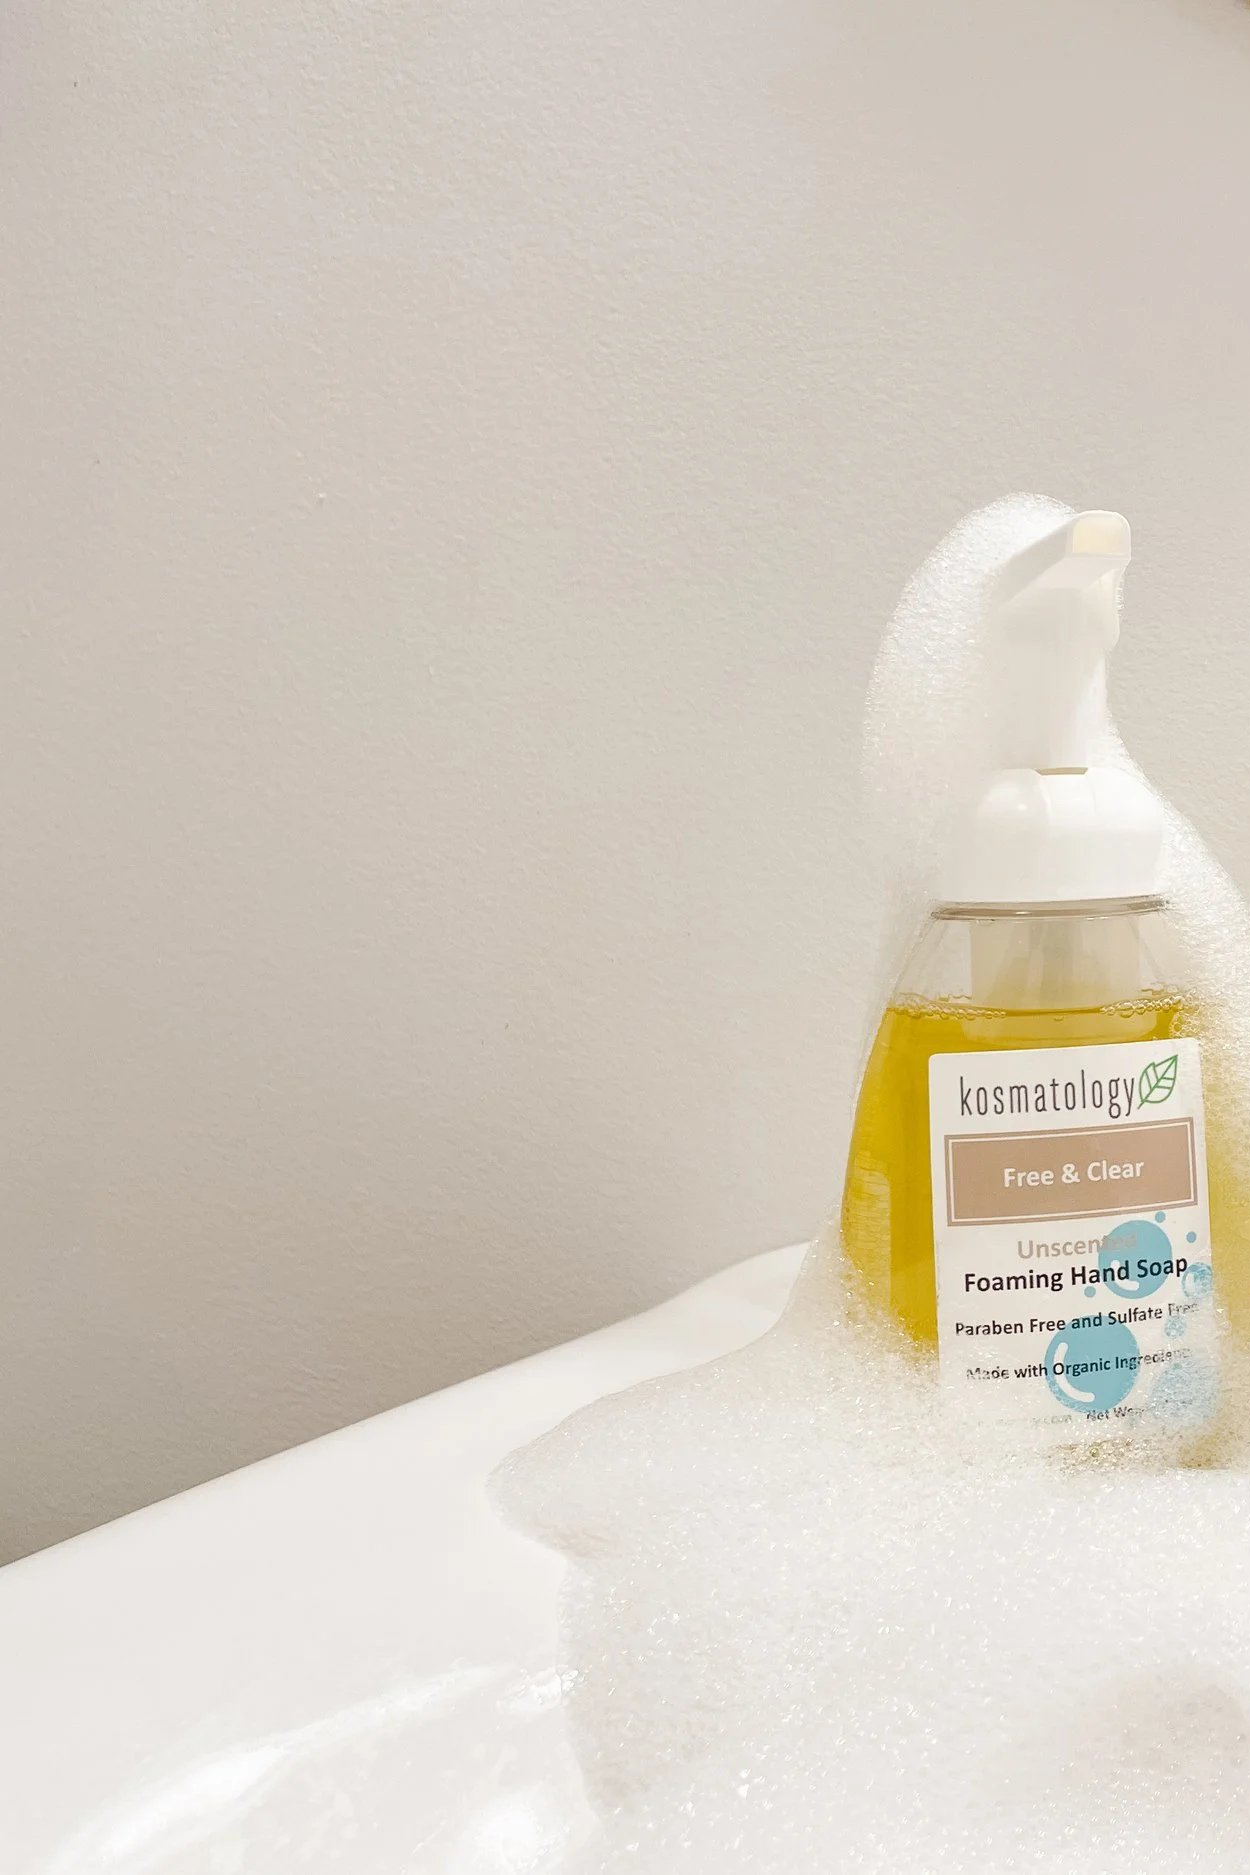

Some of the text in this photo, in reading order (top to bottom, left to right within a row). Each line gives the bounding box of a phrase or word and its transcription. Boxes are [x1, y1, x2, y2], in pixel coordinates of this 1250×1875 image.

[959, 1069, 1135, 1119] kosmatology
[1003, 1159, 1145, 1188] Free & Clear
[964, 1256, 1189, 1293] Foaming Hand Soap
[955, 1320, 1024, 1336] Paraben
[1029, 1318, 1066, 1333] Free
[1071, 1311, 1103, 1329] and
[1107, 1306, 1163, 1326] Sulfate
[1014, 1363, 1048, 1379] with
[1053, 1358, 1111, 1380] Organic
